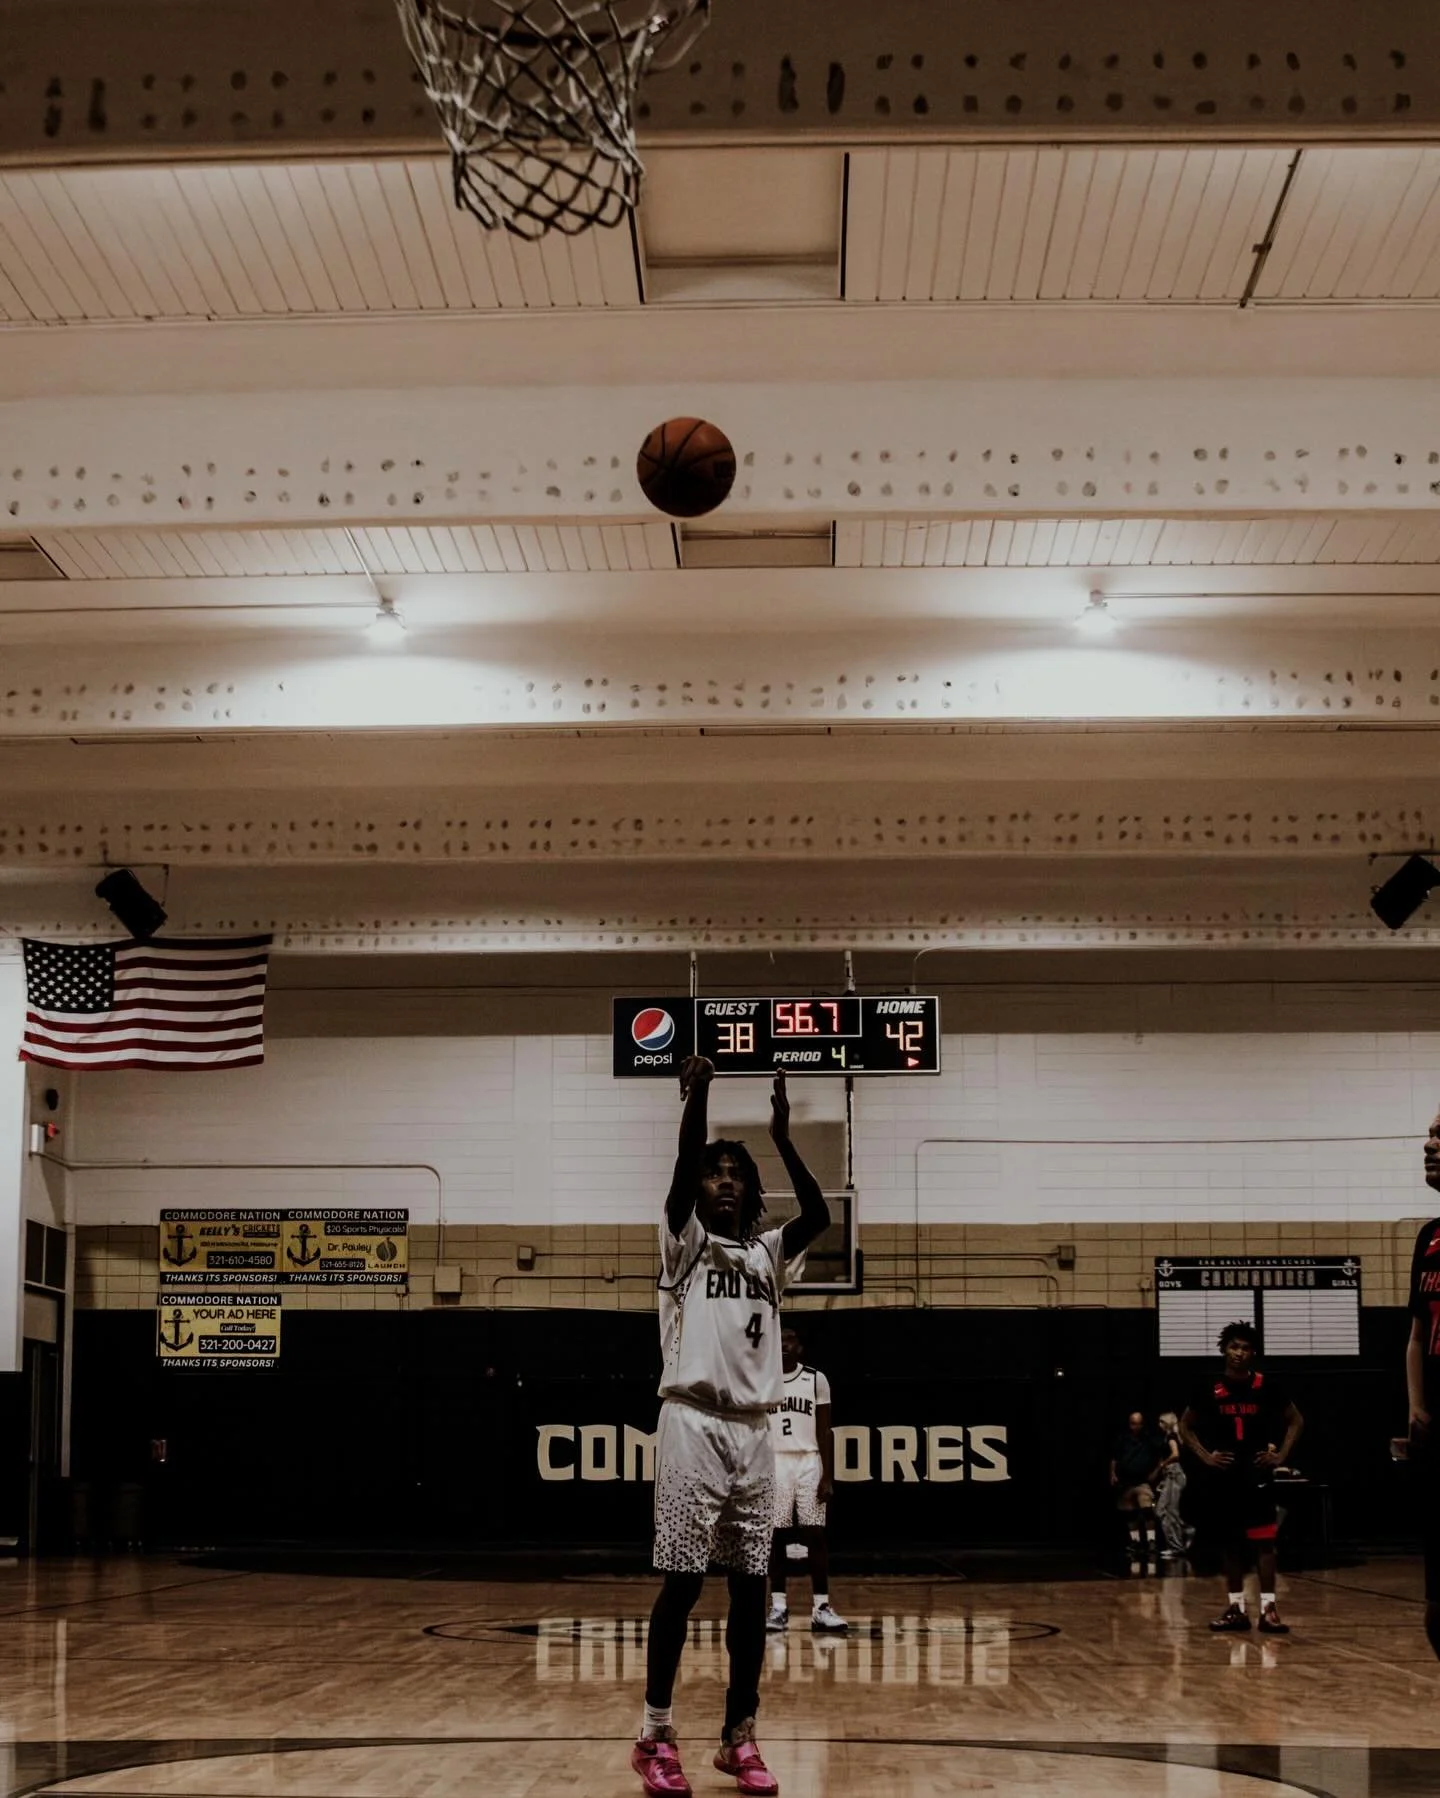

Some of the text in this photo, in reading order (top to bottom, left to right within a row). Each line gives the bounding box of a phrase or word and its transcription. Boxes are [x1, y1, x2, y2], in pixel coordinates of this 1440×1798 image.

[704, 1002, 759, 1016] GUEST
[876, 1001, 926, 1014] HOME
[775, 1002, 838, 1034] 56.7
[716, 1022, 754, 1053] 38
[885, 1021, 924, 1052] 42
[634, 1052, 673, 1067] pepsi
[772, 1044, 846, 1068] PERIOD 4
[164, 1211, 281, 1220] COMMODORE NATION
[287, 1210, 405, 1219] COMMODORE NATION
[326, 1225, 342, 1234] $20
[342, 1225, 367, 1234] Sports
[327, 1243, 371, 1253] Dr. Pauley
[208, 1255, 272, 1265] 321-610-4580
[165, 1274, 277, 1282] THANKS ITS SPONSORS!
[289, 1273, 402, 1282] THANKS ITS SPONSORS!
[706, 1268, 741, 1299] EAU
[1158, 1280, 1182, 1289] BOYS
[161, 1296, 278, 1305] COMMODORE NATION
[193, 1309, 276, 1319] YOUR AD HERE
[745, 1313, 763, 1348] 4
[199, 1339, 275, 1350] 321-200-0427
[162, 1359, 275, 1368] THANKS ITS SPONSORS!
[782, 1418, 792, 1436] 2
[1233, 1416, 1244, 1441] 1
